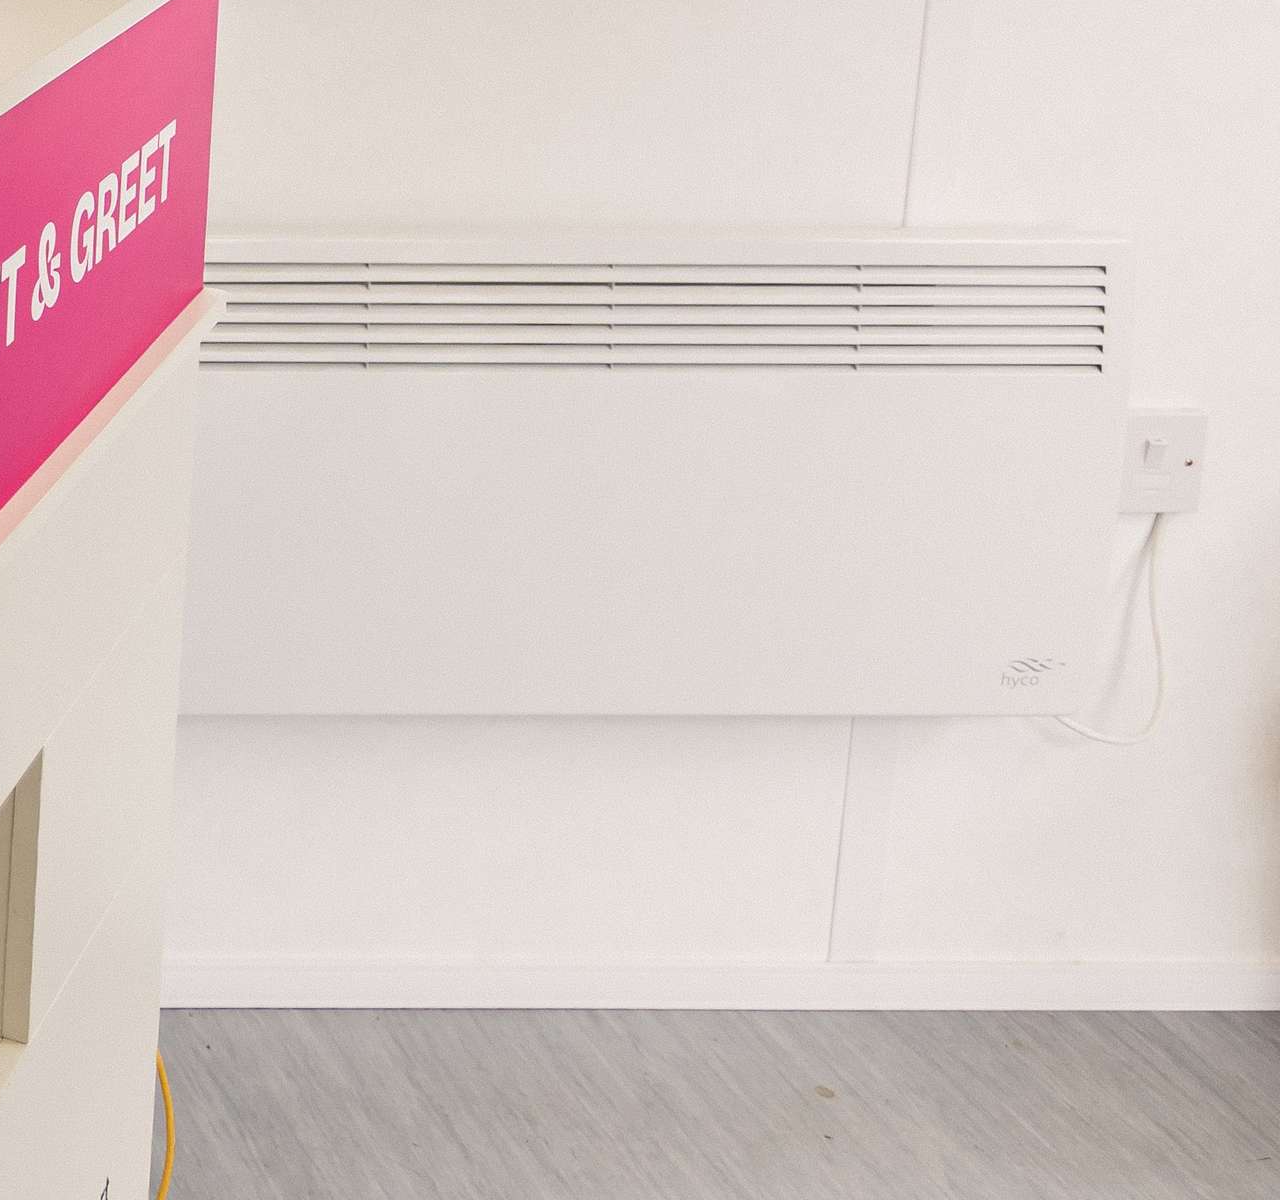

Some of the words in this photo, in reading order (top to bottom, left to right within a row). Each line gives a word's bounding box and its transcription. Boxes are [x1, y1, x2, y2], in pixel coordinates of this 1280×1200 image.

[30, 221, 63, 323] &
[70, 119, 178, 284] GREET
[1000, 672, 1039, 689] hyco
